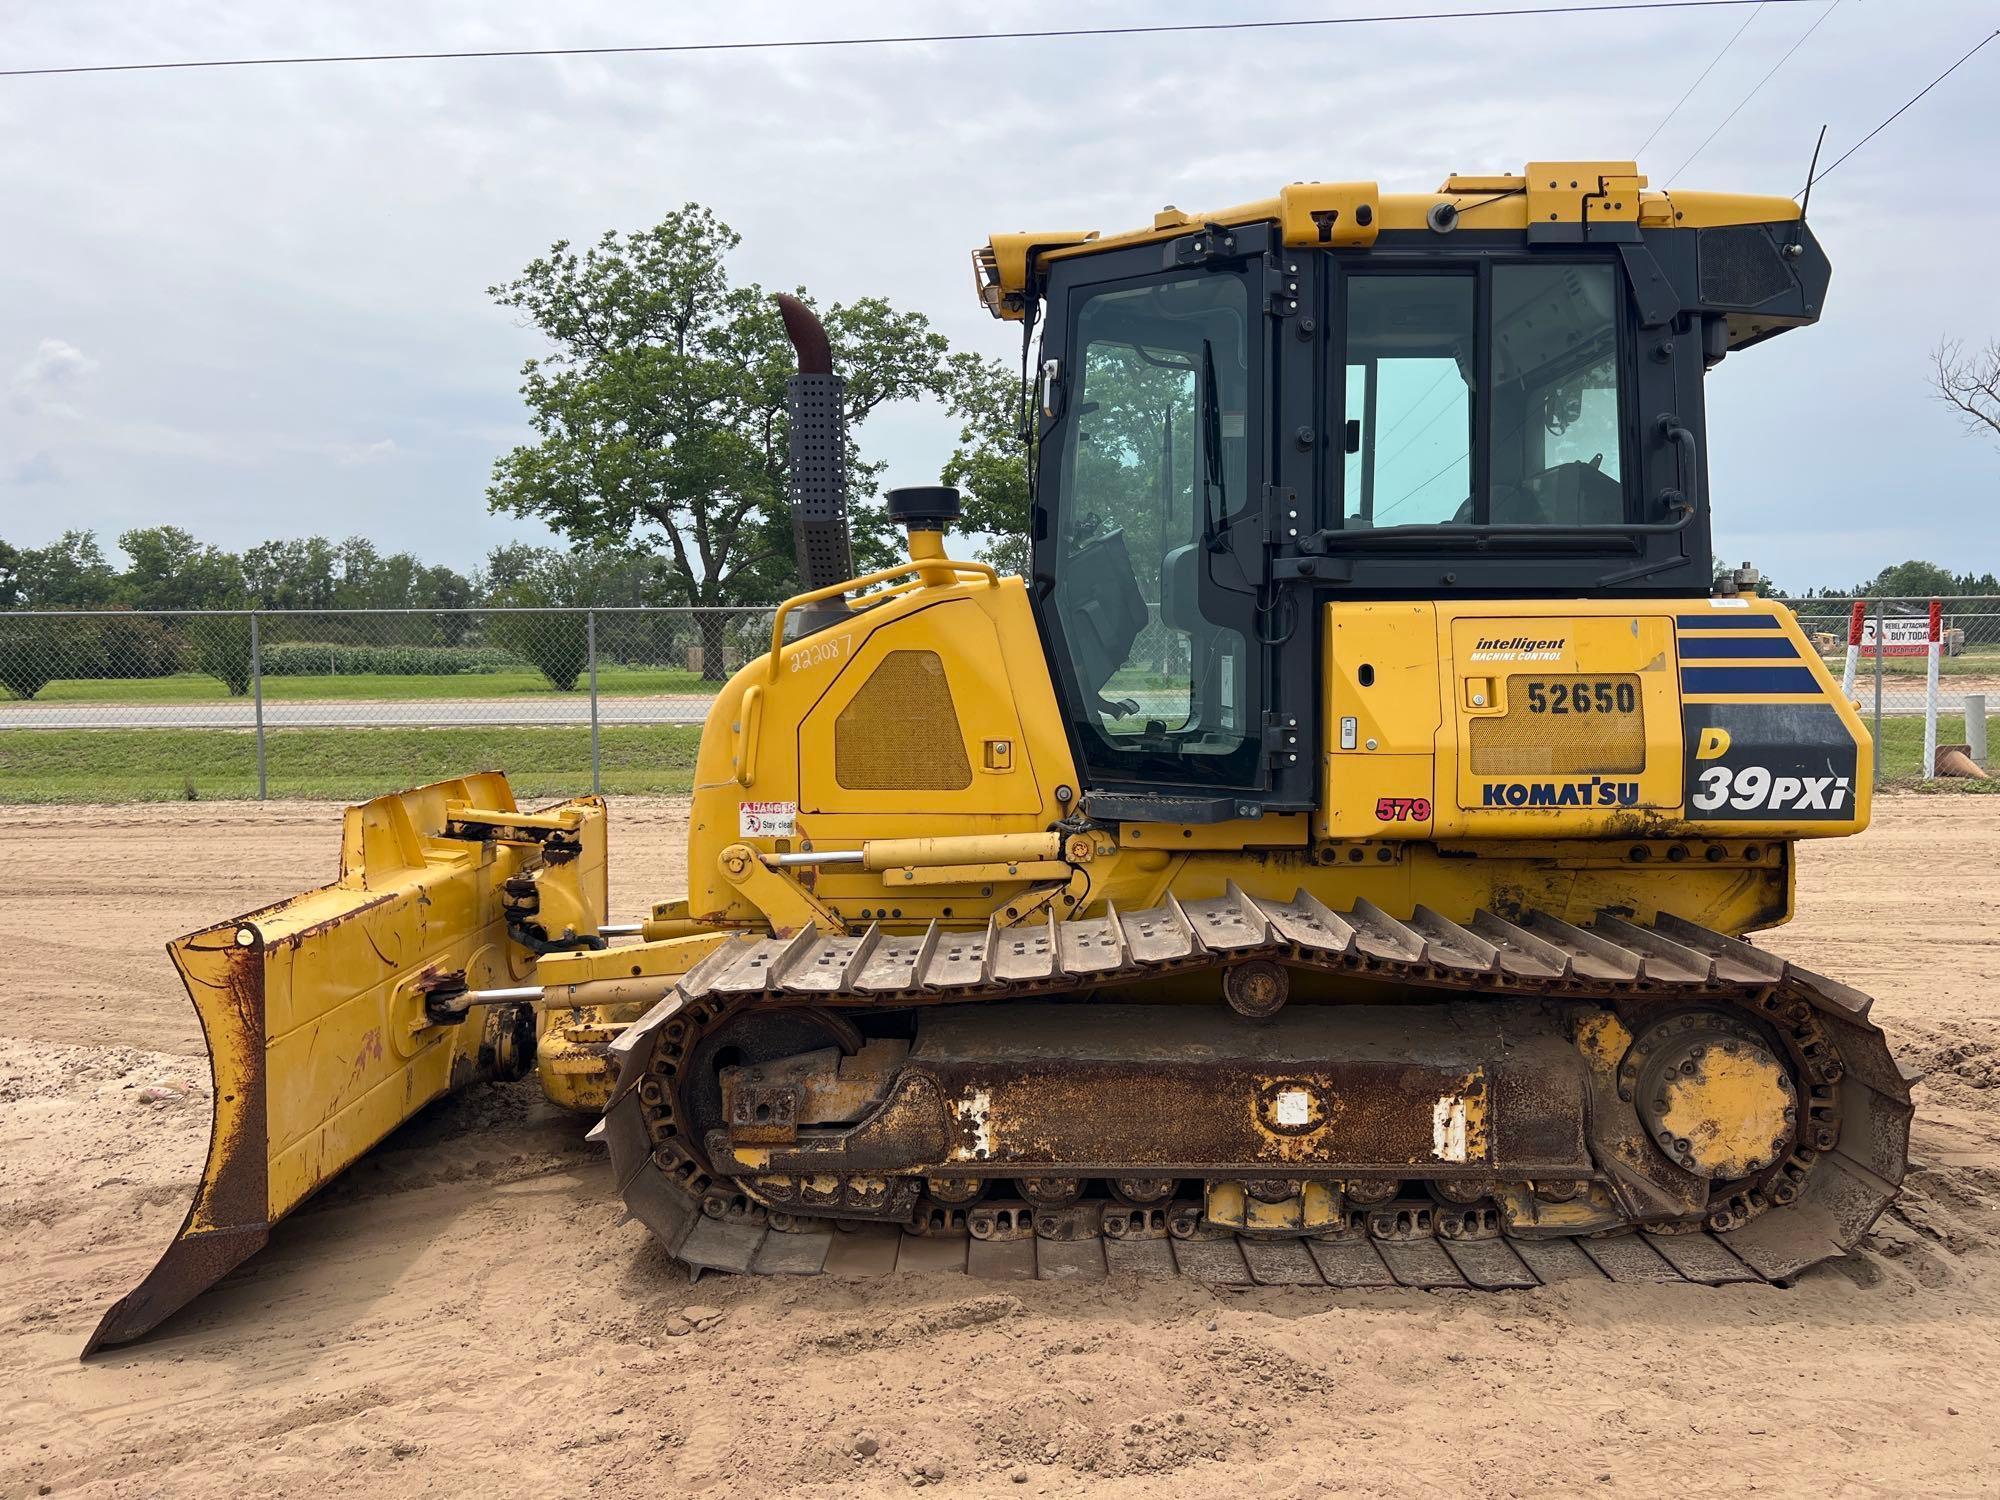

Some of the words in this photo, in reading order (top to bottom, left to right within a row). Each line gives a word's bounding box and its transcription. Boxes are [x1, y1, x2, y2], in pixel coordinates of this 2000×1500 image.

[1476, 637, 1565, 652] intelligent
[1891, 632, 1906, 640] BUY
[791, 634, 852, 673] 222087
[1471, 652, 1515, 661] MACHINE
[1517, 652, 1561, 661] CONTROL
[1528, 682, 1635, 714] 52650
[1696, 727, 1731, 760] D
[1483, 776, 1639, 806] KOMATSU
[1692, 766, 1849, 811] 39PXi
[1376, 798, 1431, 821] 579
[762, 820, 775, 830] Stay
